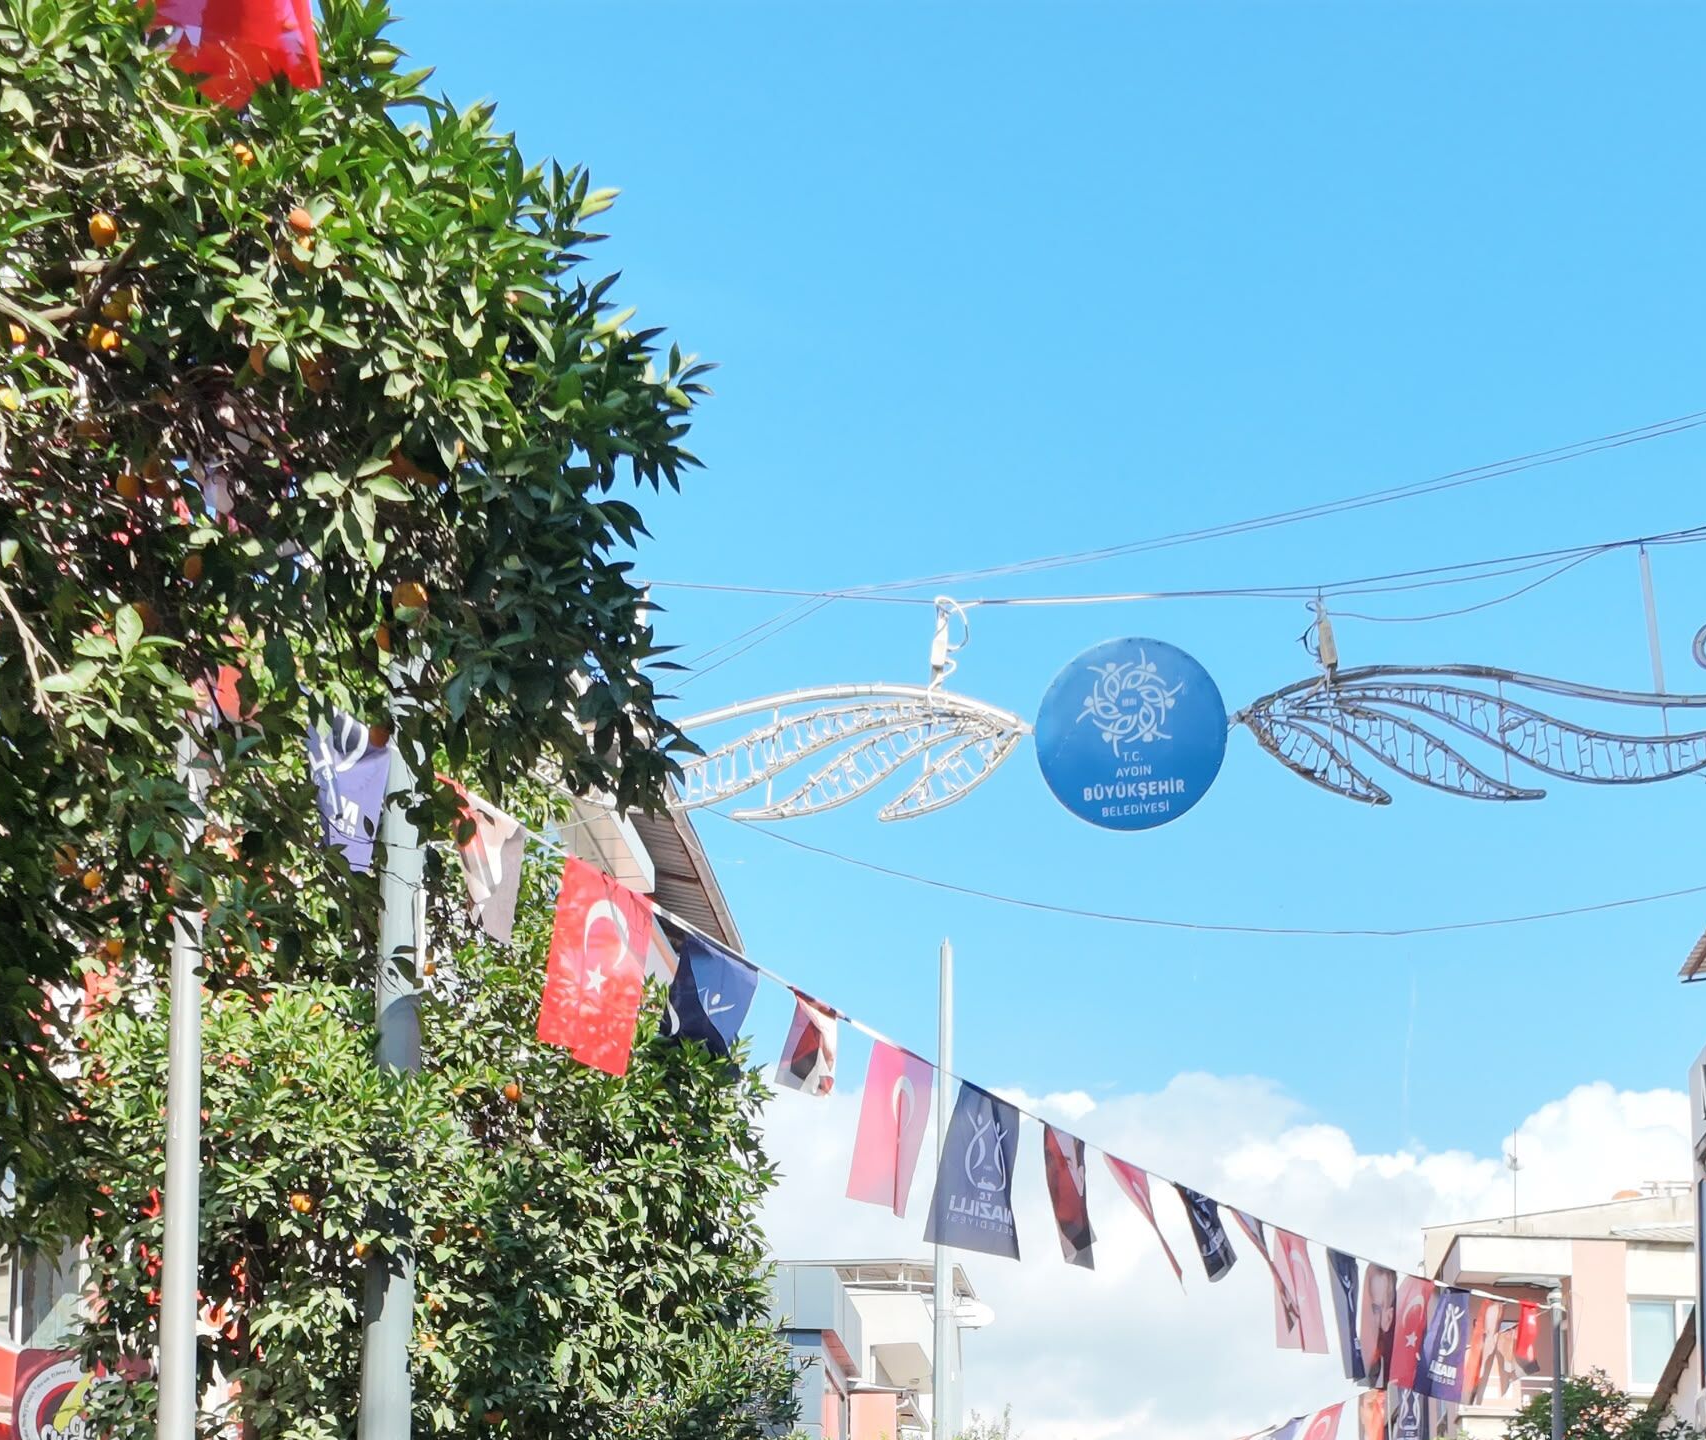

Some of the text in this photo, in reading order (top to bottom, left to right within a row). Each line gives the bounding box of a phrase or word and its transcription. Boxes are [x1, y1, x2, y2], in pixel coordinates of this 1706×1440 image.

[1122, 751, 1143, 763] T.C.
[1115, 765, 1153, 778] AYDIN
[1082, 779, 1186, 803] BÜYÜKŞEHİR
[1101, 799, 1170, 818] BELEDİYESİ
